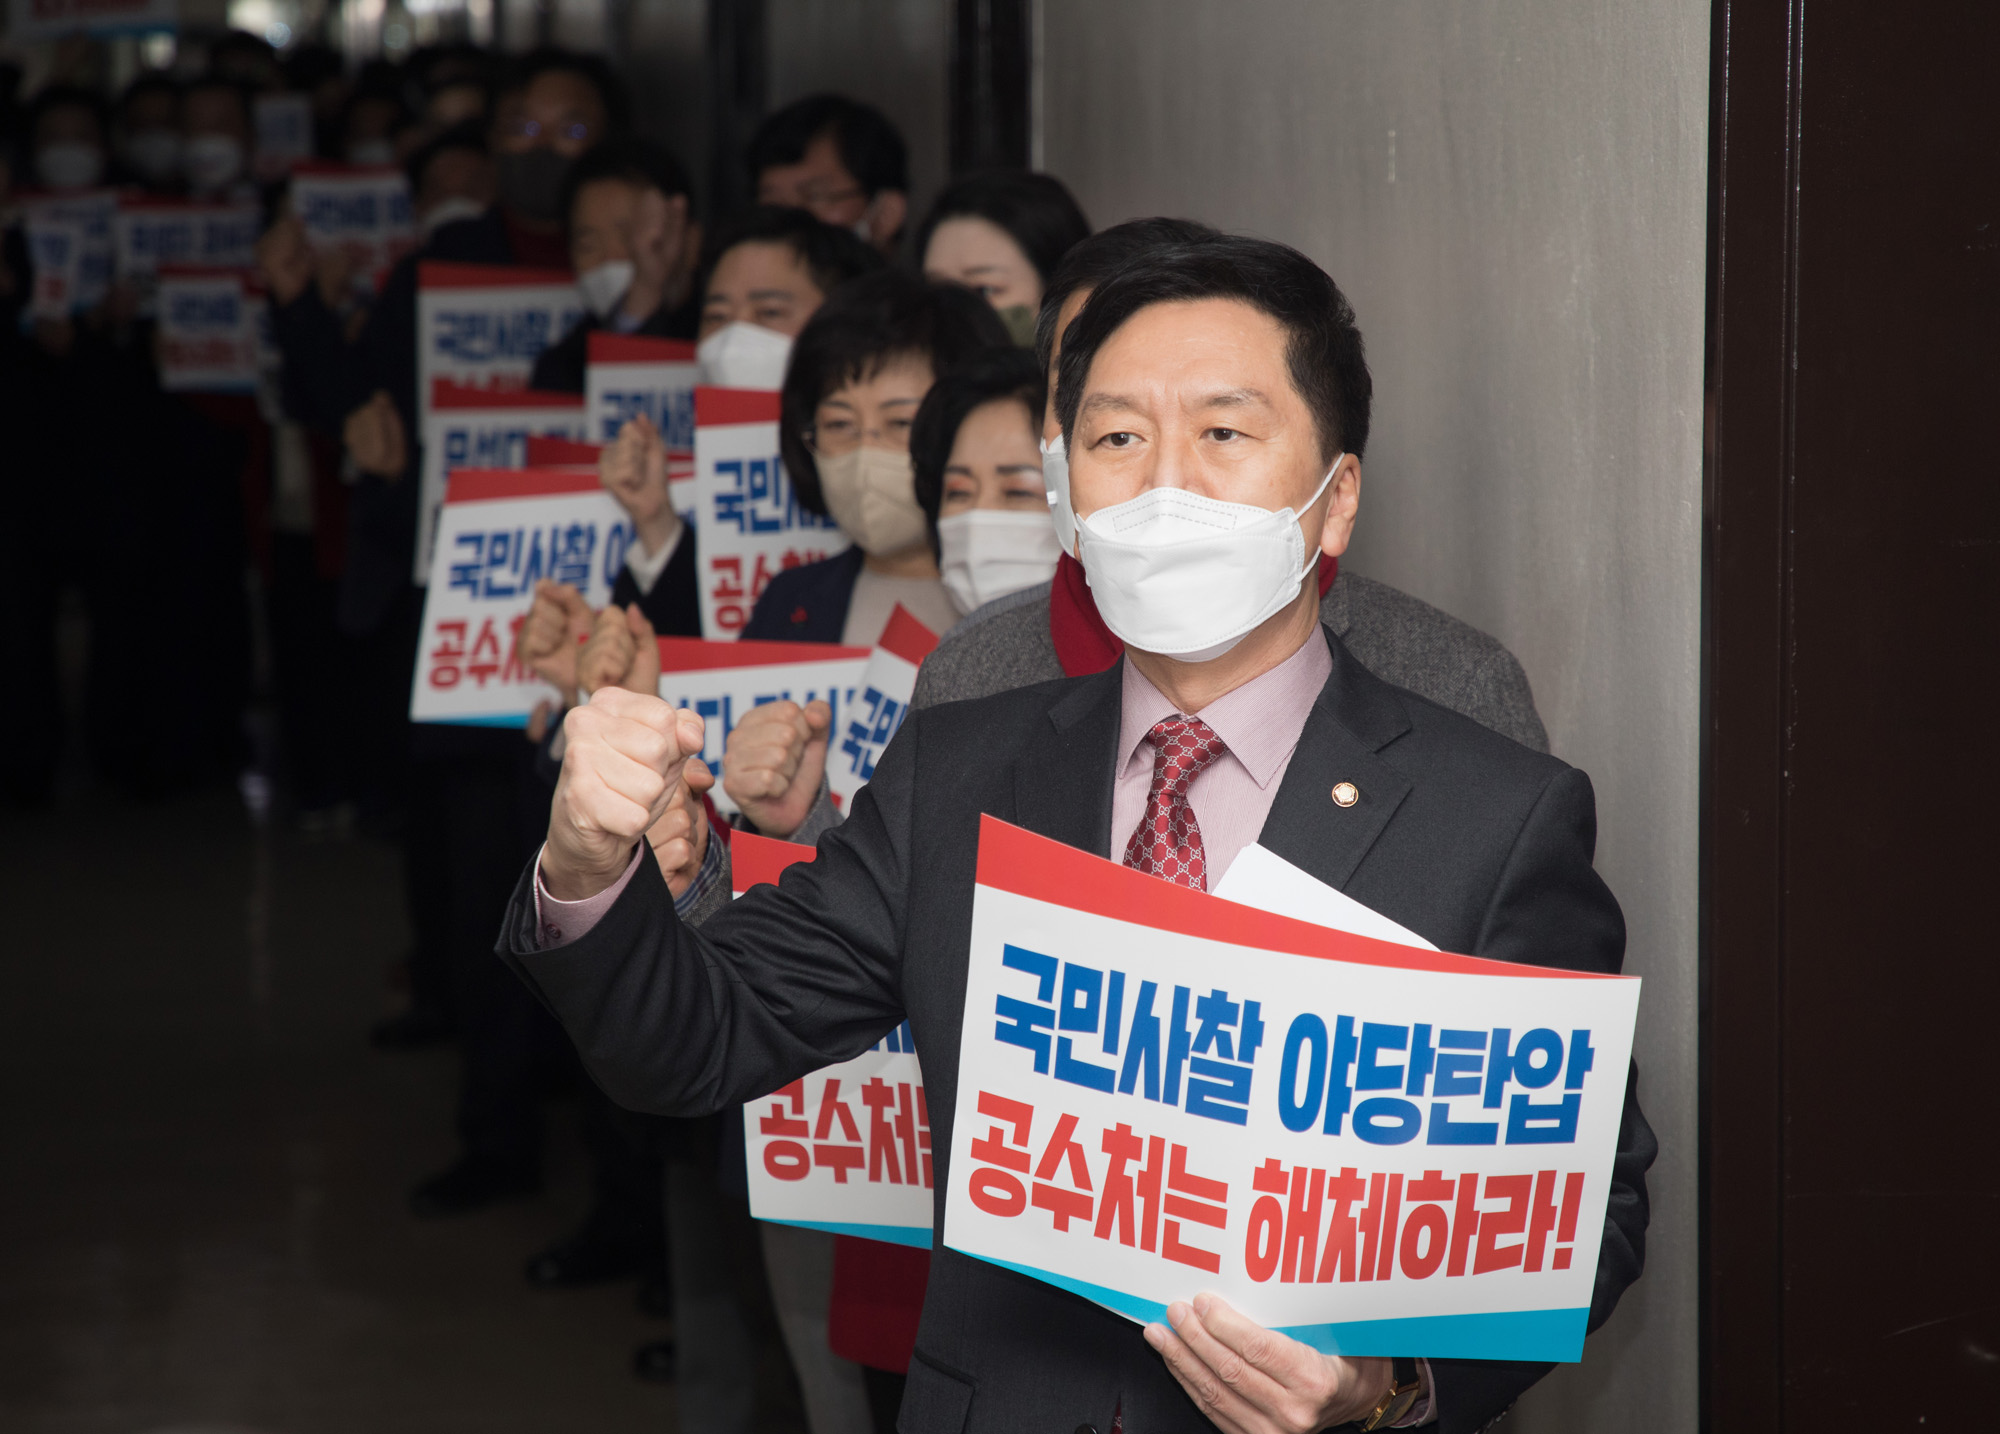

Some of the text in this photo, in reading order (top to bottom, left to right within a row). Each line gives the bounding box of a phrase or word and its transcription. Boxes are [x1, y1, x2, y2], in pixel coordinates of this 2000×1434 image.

[994, 942, 1596, 1146] 국민사찰 야당탄압
[968, 1089, 1586, 1284] 공수처는 해체하라!
